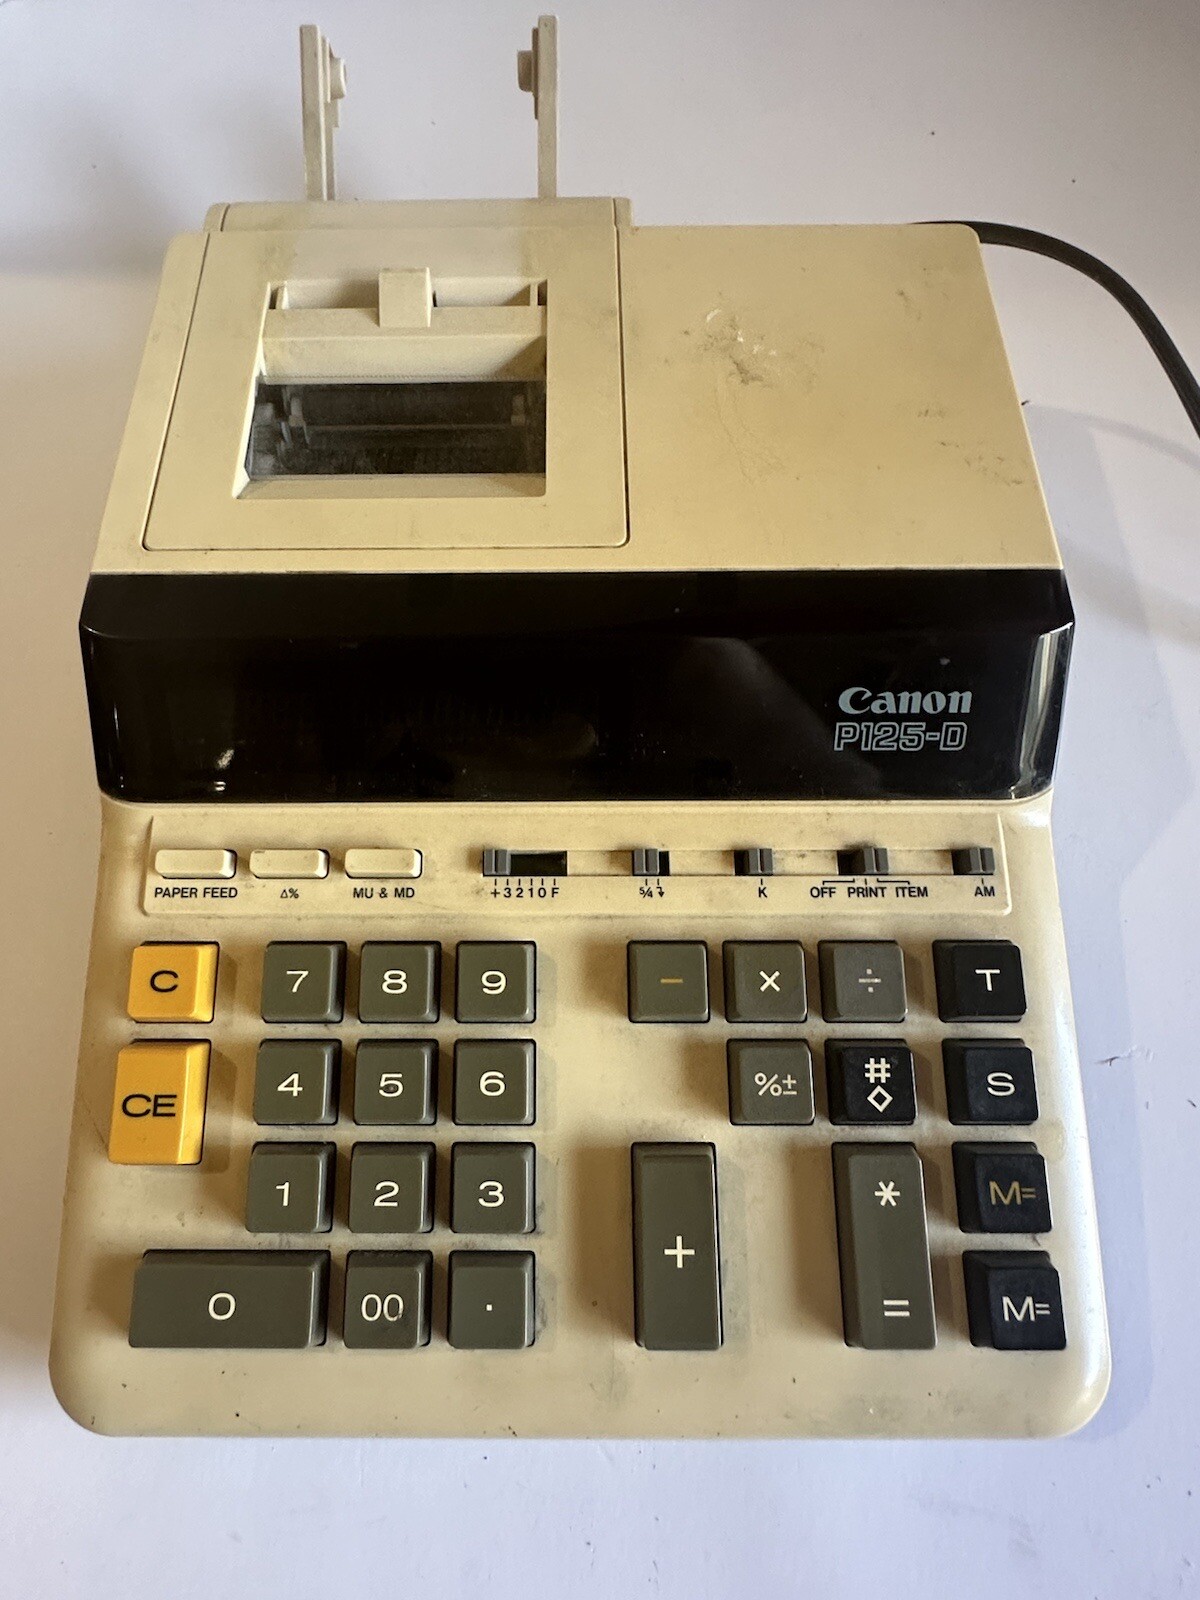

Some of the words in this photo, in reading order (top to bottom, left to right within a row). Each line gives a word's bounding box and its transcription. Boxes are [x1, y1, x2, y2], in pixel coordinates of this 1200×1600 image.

[838, 686, 973, 715] Canon
[833, 721, 968, 752] P125-D
[154, 887, 198, 899] PAPER
[203, 887, 238, 899] FEED
[353, 887, 374, 899] MU
[378, 887, 388, 899] &
[394, 887, 415, 899] MD
[758, 886, 768, 898] K
[809, 886, 837, 899] OFF
[847, 886, 887, 898] PRINT
[895, 886, 929, 898] ITEM
[974, 886, 995, 897] AM
[149, 969, 179, 993] C
[286, 970, 309, 993] 7
[381, 970, 408, 994] 8
[481, 970, 507, 995] 9
[975, 969, 1001, 992] T
[864, 1057, 891, 1084] #
[277, 1073, 303, 1097] 4
[378, 1073, 404, 1098] 5
[479, 1071, 506, 1097] 6
[987, 1072, 1016, 1097] S
[121, 1093, 178, 1118] CE
[275, 1181, 290, 1207] 1
[373, 1181, 400, 1207] 2
[478, 1180, 504, 1208] 3
[664, 1235, 695, 1269] +
[208, 1292, 236, 1321] 0
[361, 1293, 404, 1322] 00
